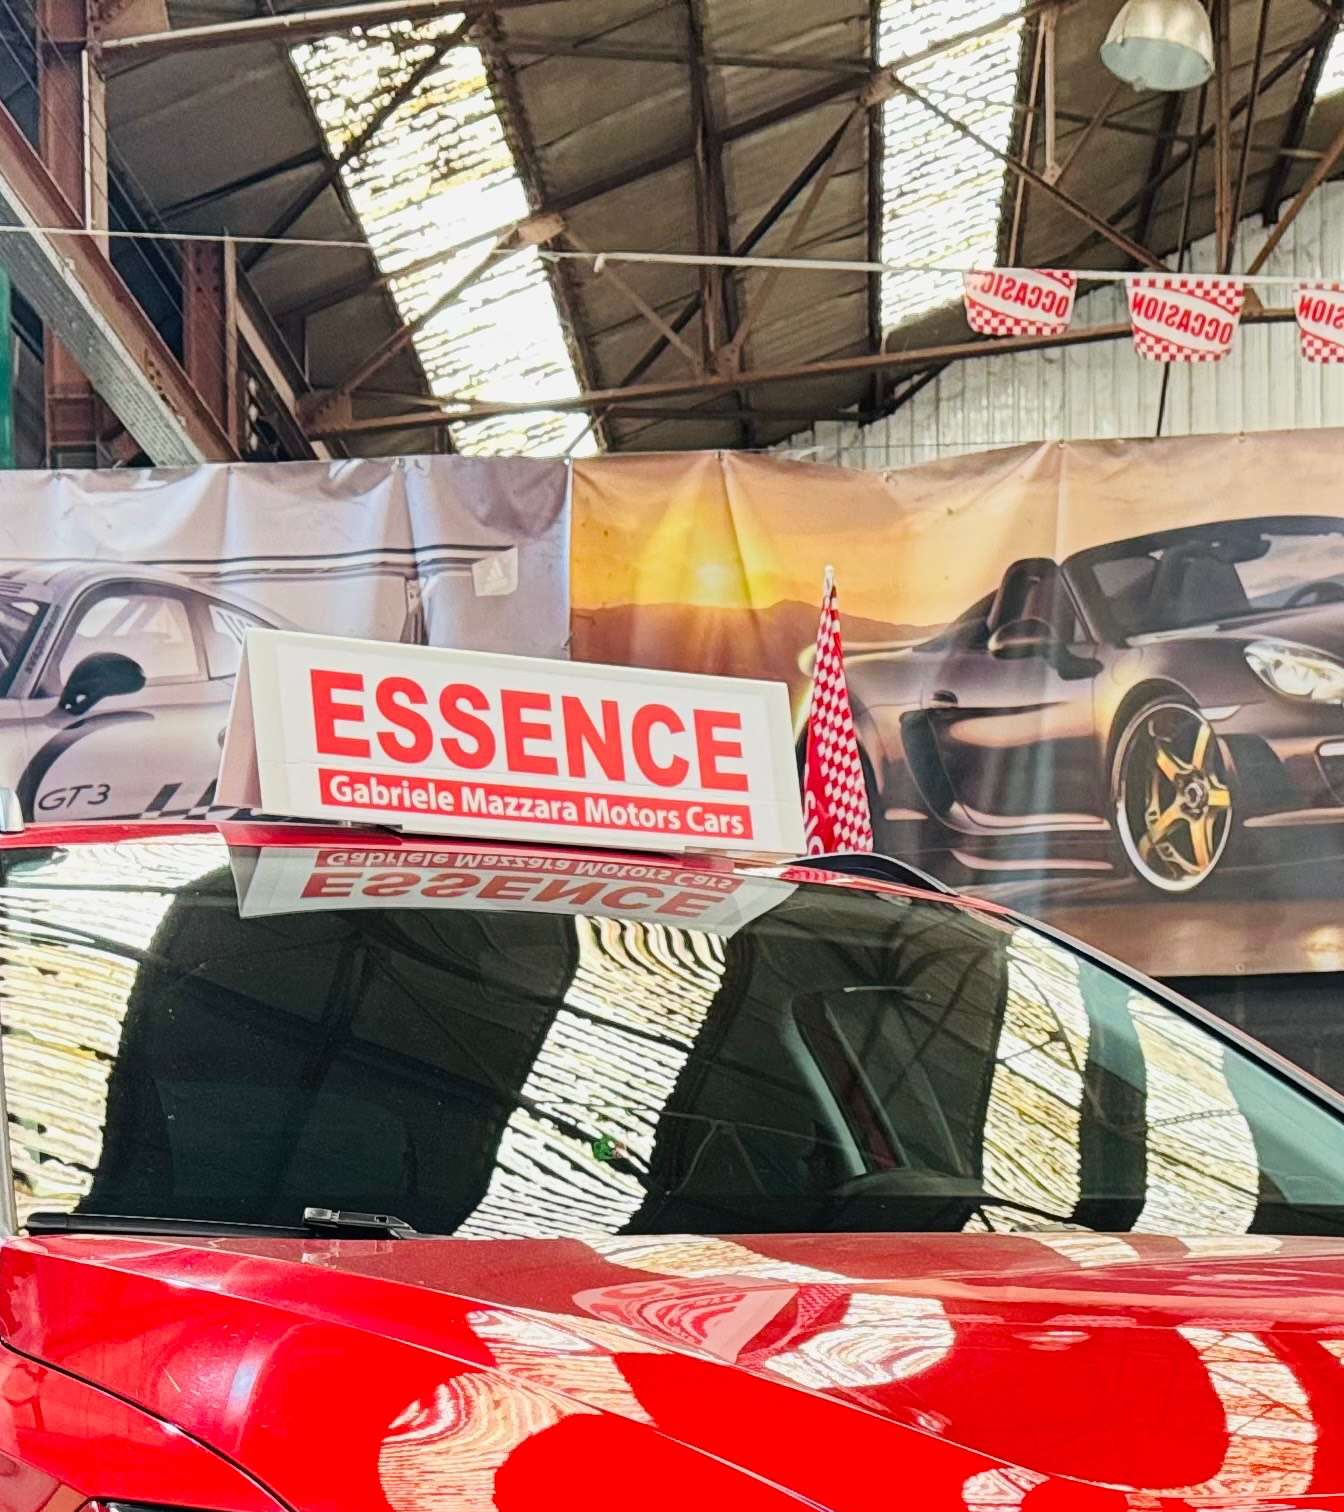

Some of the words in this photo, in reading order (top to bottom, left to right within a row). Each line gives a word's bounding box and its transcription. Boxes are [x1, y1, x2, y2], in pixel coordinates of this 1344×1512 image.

[309, 668, 749, 792] ESSENCE
[329, 774, 454, 812] Gabriele
[461, 786, 578, 822] Mazzara
[584, 796, 682, 829] Motors
[686, 806, 745, 835] Cars
